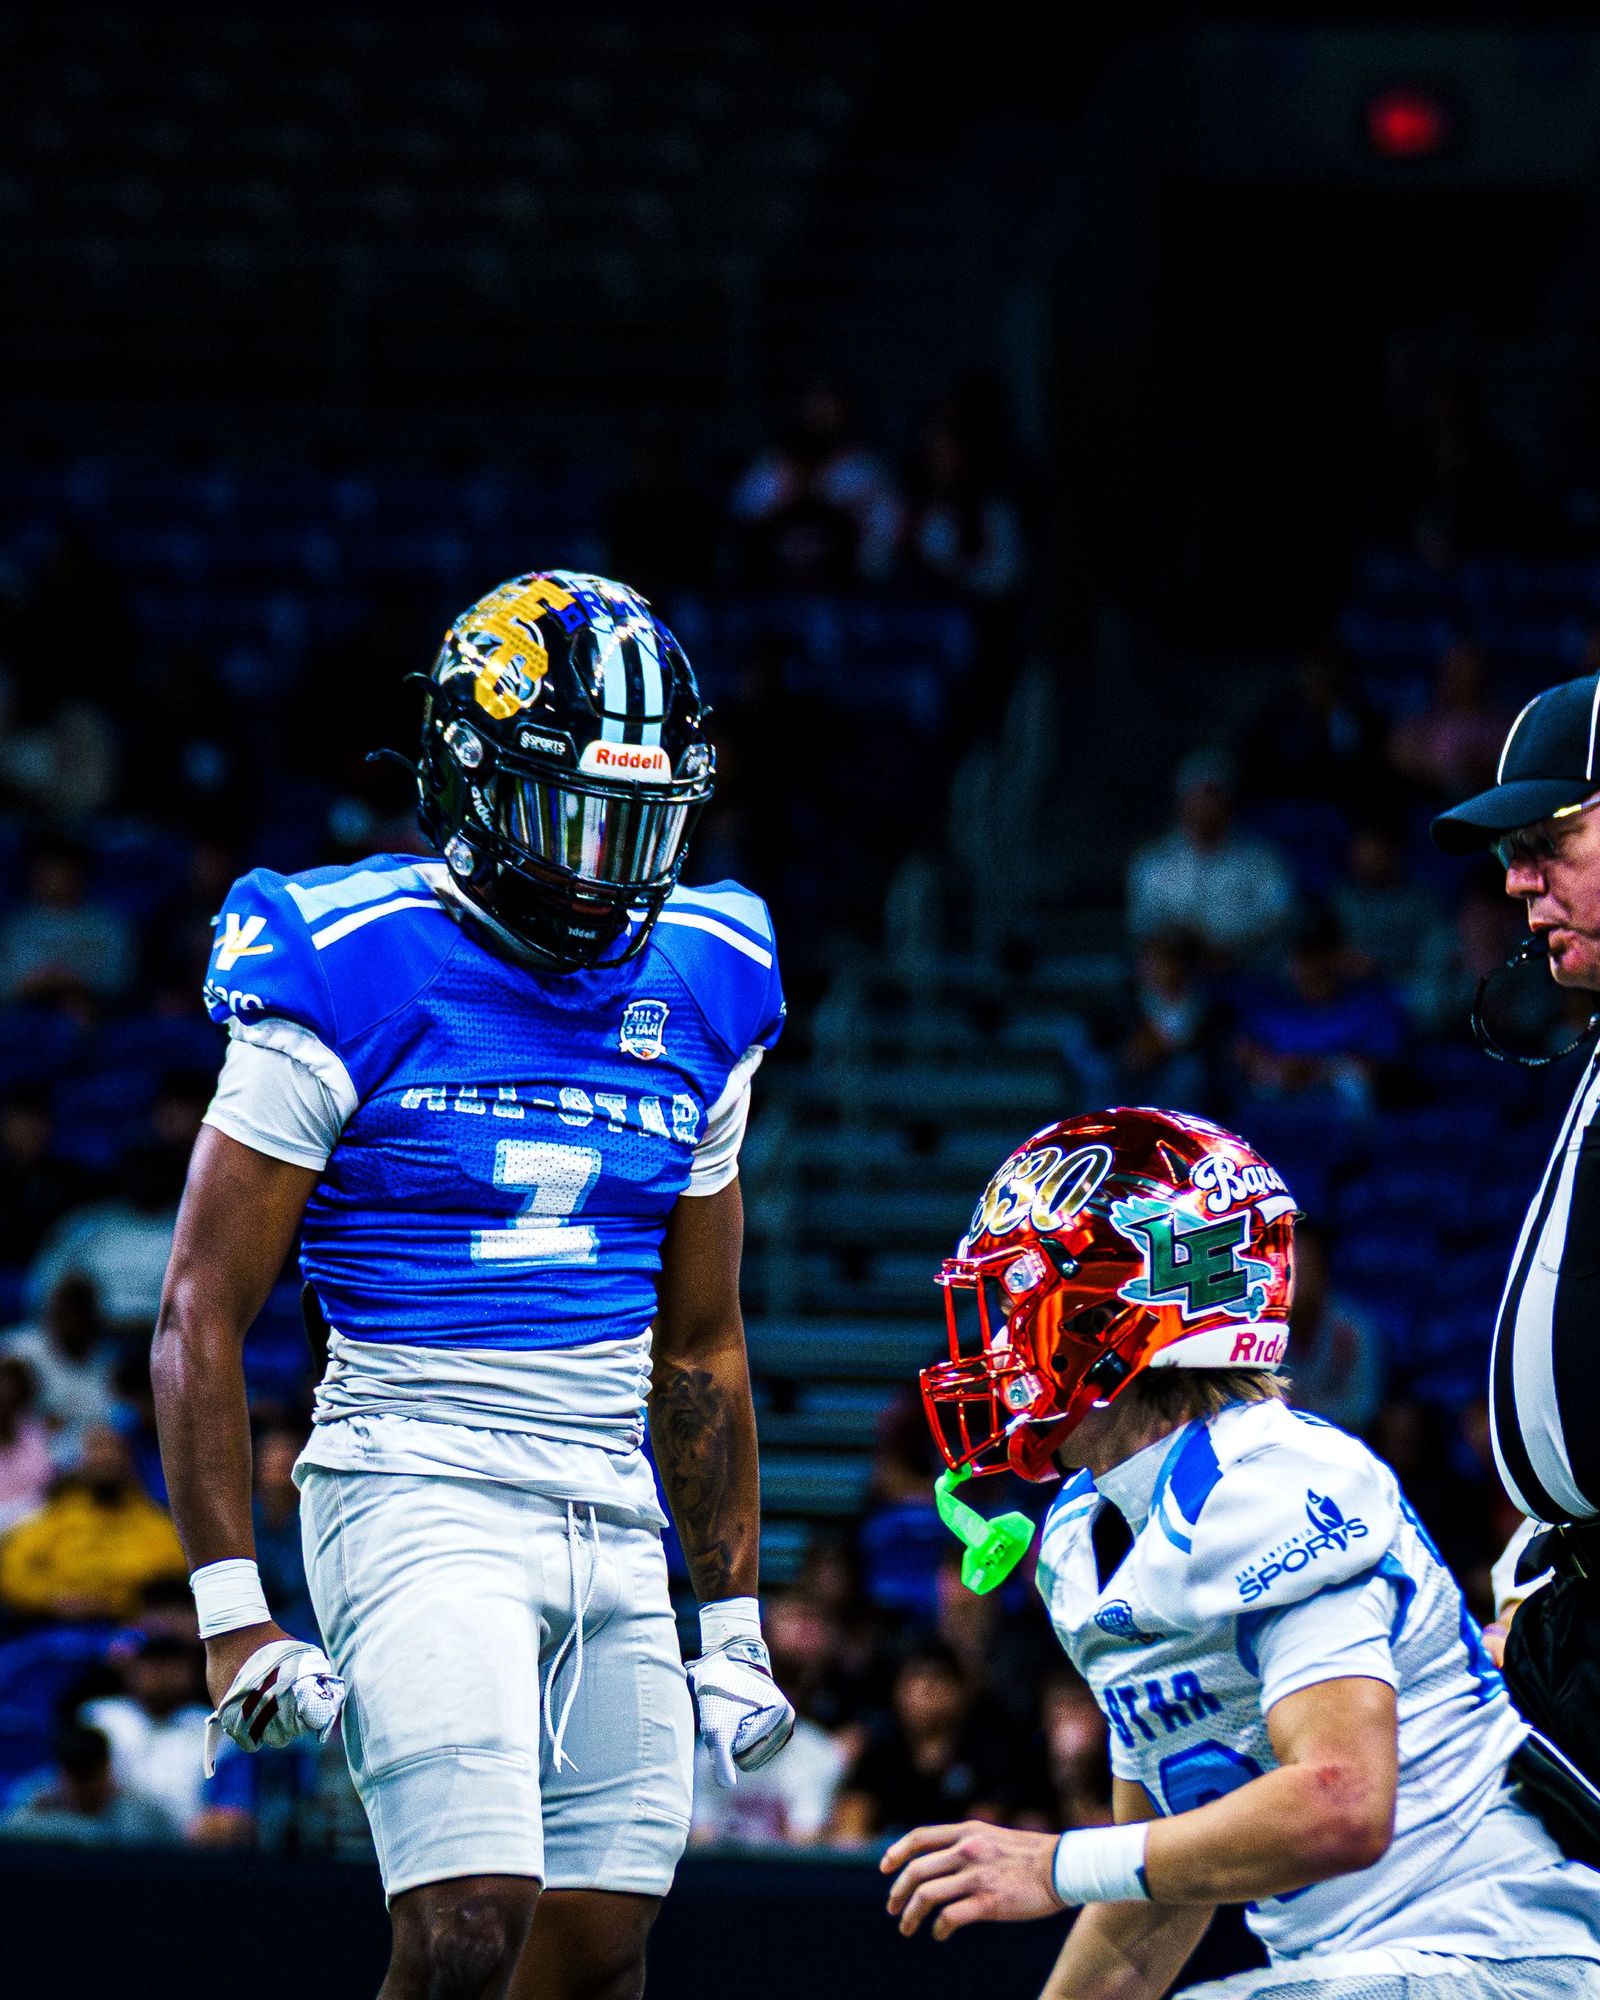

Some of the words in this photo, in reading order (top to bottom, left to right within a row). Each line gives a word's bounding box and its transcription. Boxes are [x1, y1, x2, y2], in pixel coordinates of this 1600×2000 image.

[595, 747, 663, 770] Riddell
[400, 1086, 700, 1144] ALL-STAR
[470, 1138, 602, 1267] 7
[1124, 1212, 1249, 1315] LE
[1238, 1517, 1369, 1604] SPORTS
